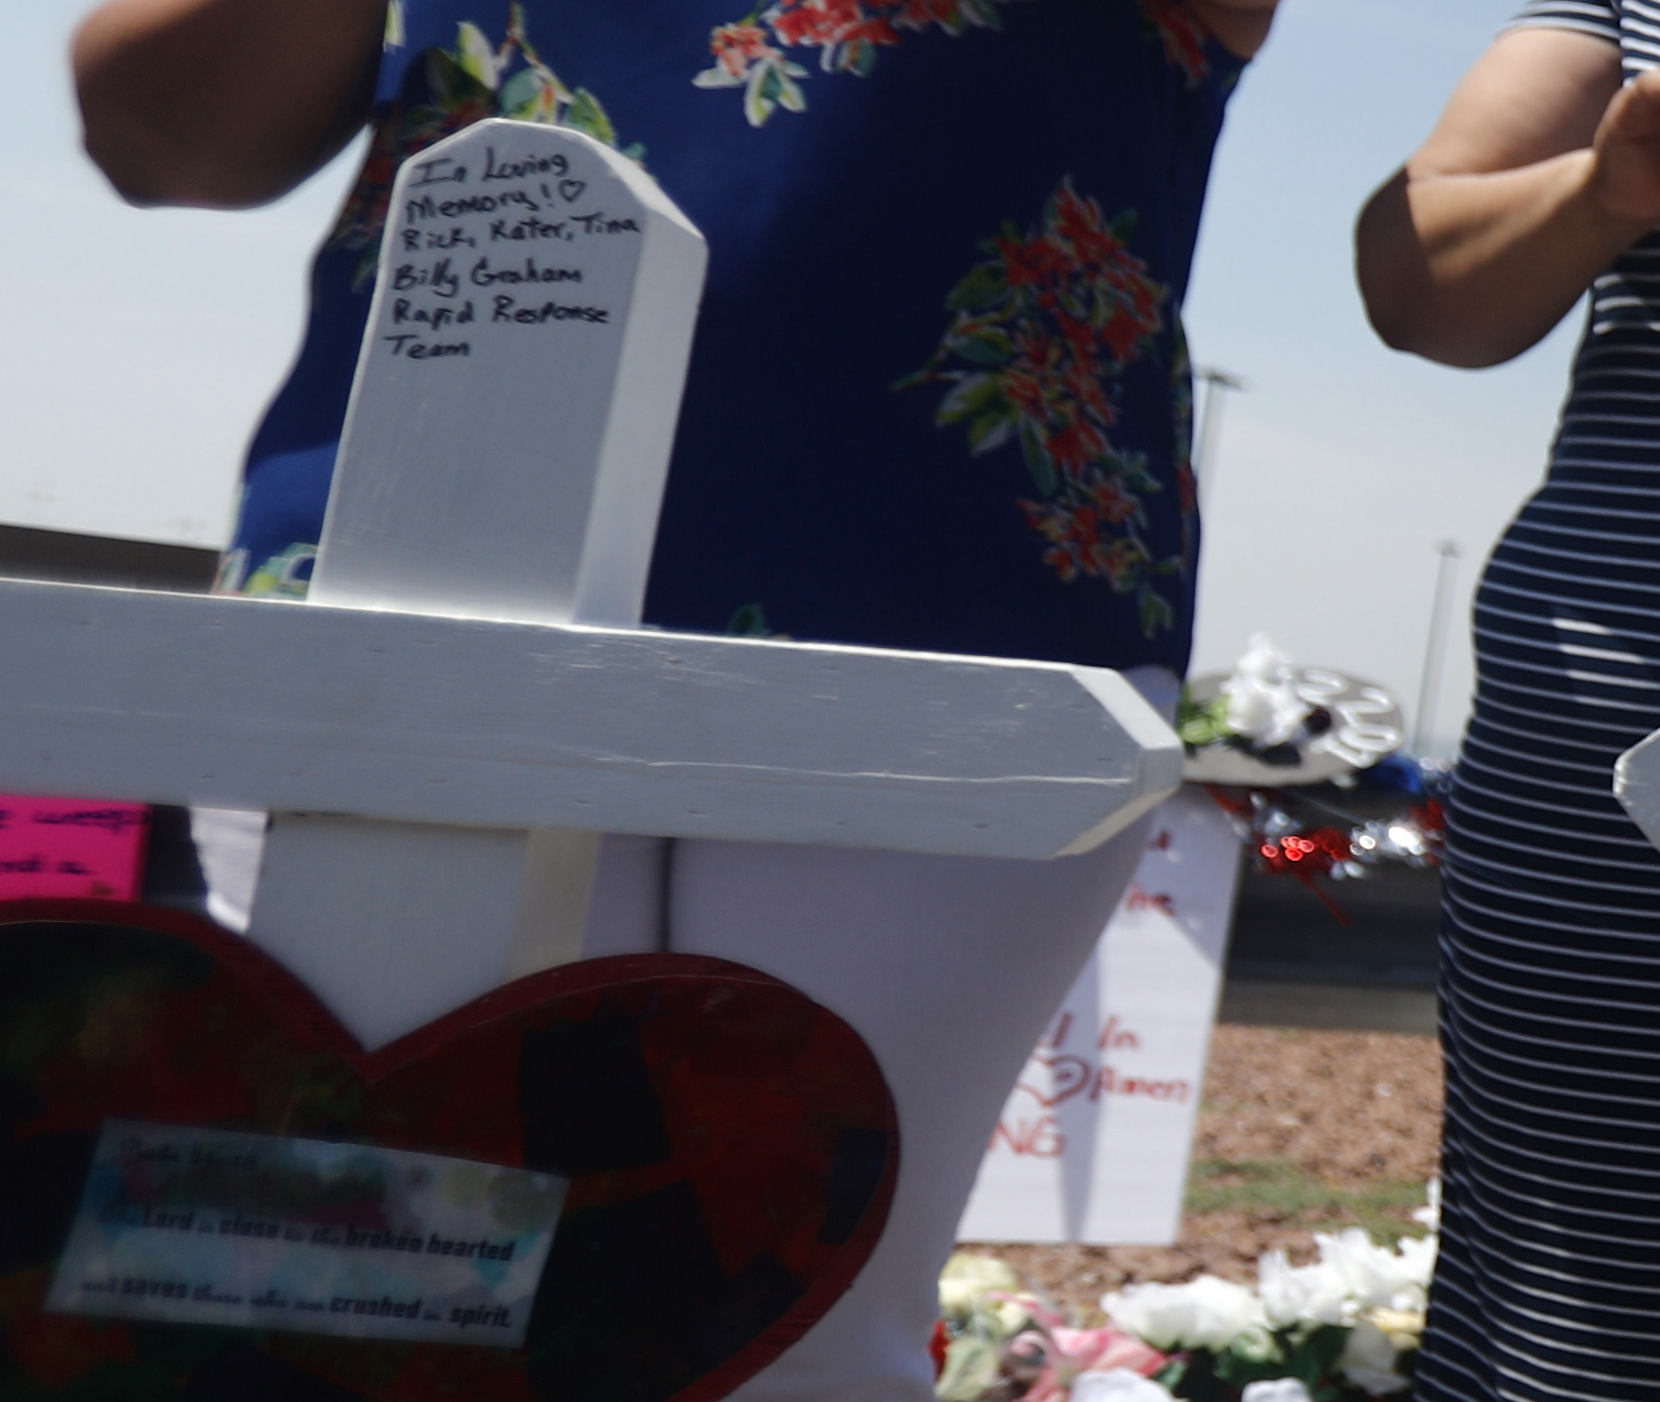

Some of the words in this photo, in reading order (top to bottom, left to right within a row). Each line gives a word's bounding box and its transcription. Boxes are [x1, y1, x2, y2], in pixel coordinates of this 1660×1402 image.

[408, 156, 465, 188] In
[483, 146, 569, 179] Loving
[392, 258, 460, 298] Billy
[472, 256, 583, 287] Graham
[392, 297, 474, 330] Rapid
[492, 295, 610, 325] Response
[382, 334, 470, 360] Team
[346, 1224, 424, 1252] broken
[426, 1231, 516, 1261] hearted
[329, 1295, 422, 1320] crushed
[449, 1304, 513, 1329] spirit.
